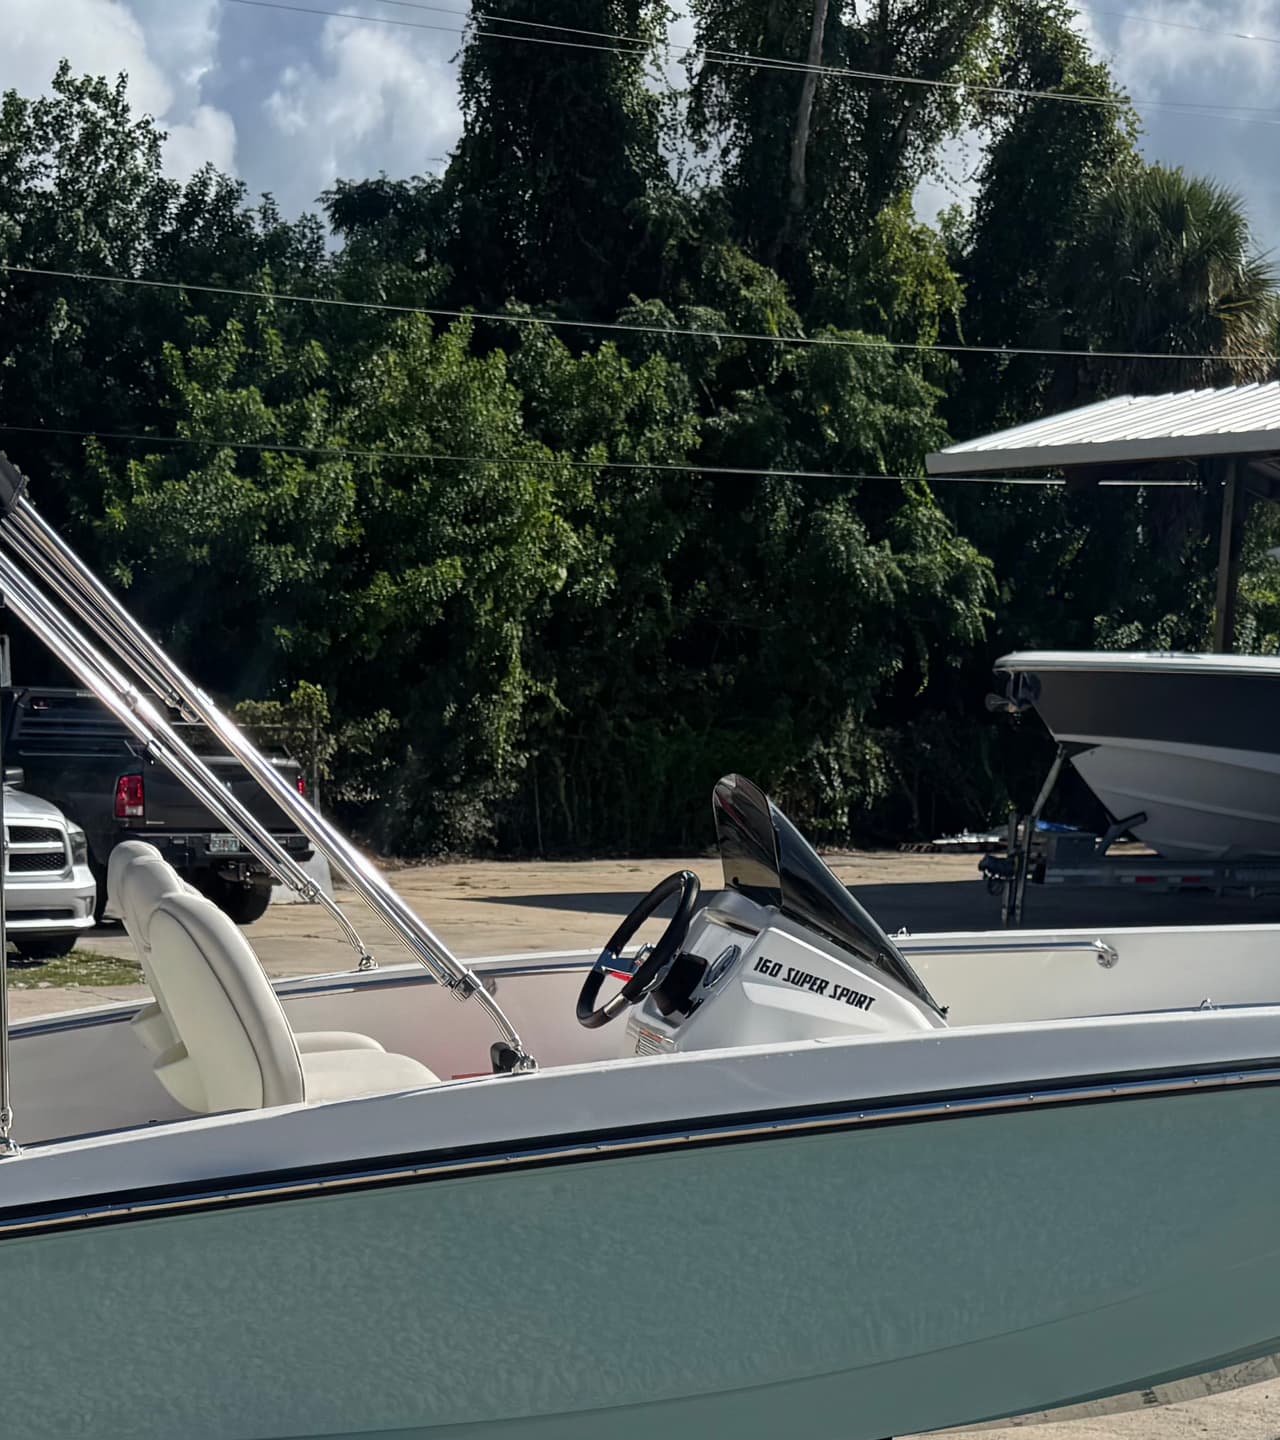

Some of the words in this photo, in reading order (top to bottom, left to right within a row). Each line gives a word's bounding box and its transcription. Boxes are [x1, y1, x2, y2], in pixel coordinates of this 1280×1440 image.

[753, 956, 783, 978] 160
[782, 967, 830, 995] SUPER
[828, 984, 876, 1011] SPORT
